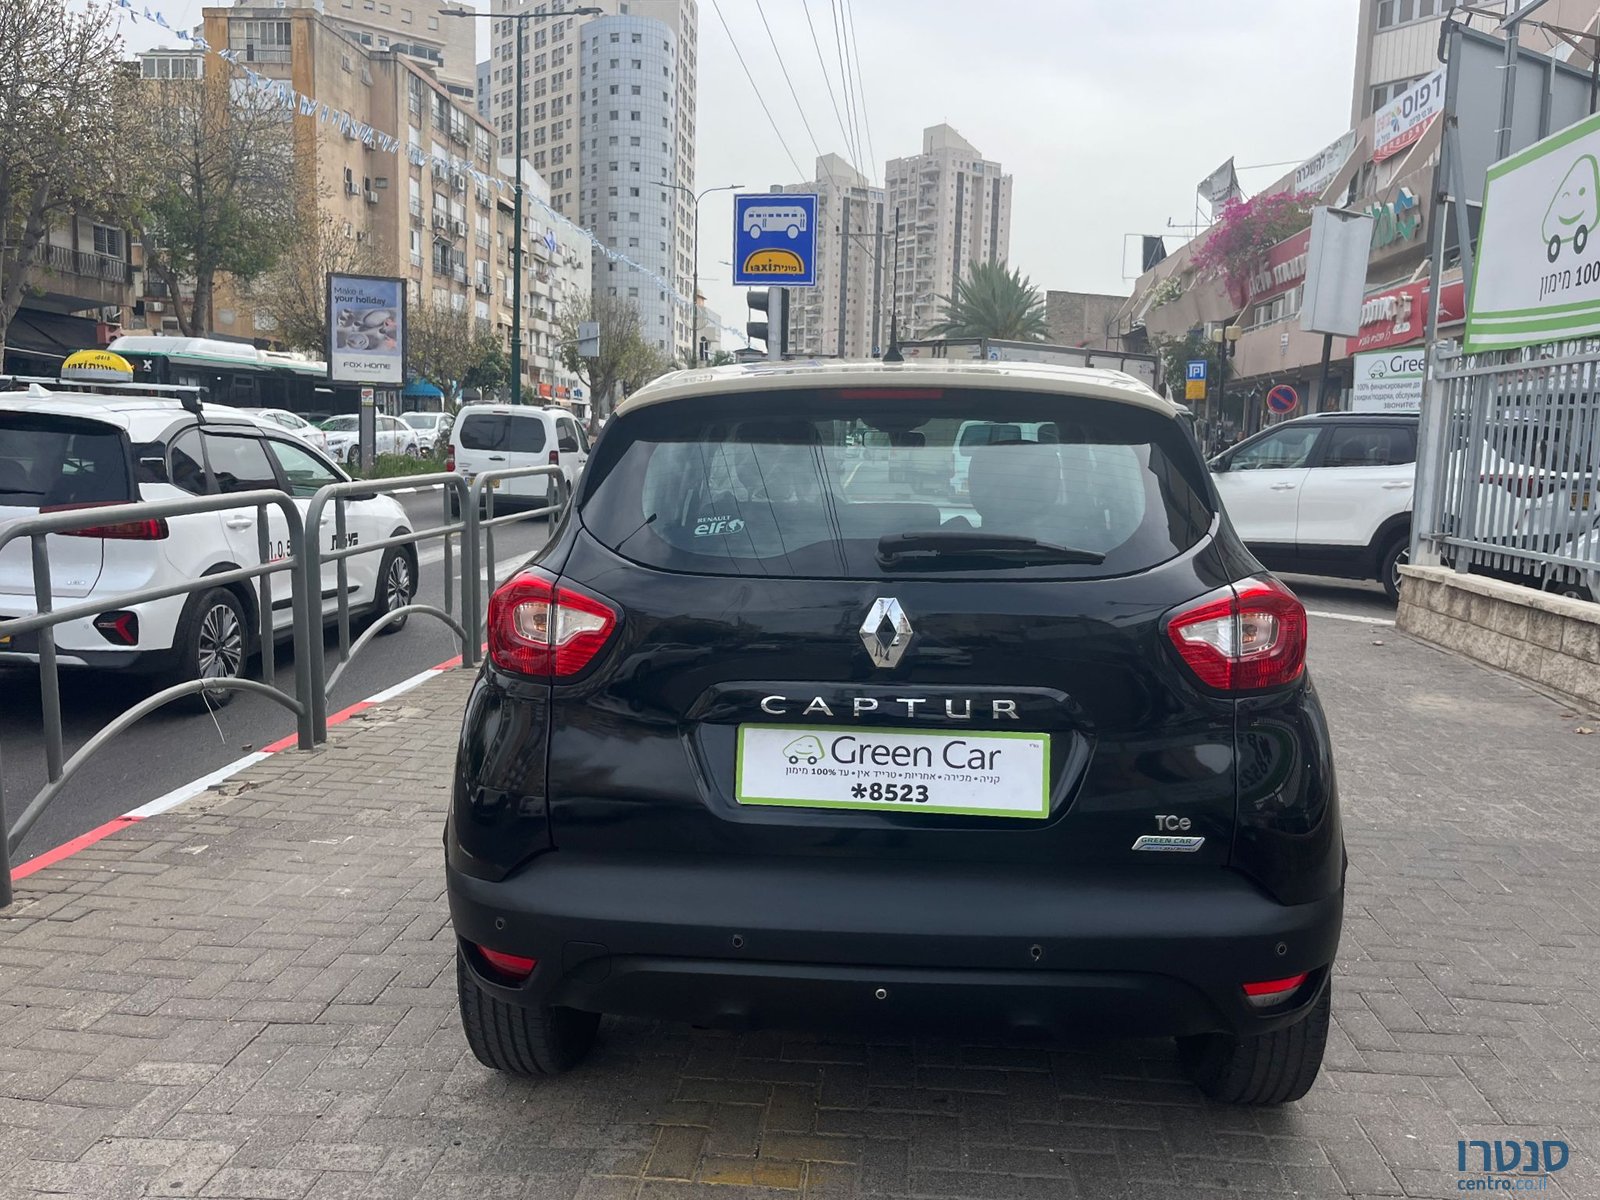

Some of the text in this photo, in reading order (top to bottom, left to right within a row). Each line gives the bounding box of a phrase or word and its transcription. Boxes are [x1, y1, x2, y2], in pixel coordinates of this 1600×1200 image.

[1402, 73, 1442, 118] דפוס
[334, 287, 357, 295] Make
[1539, 270, 1571, 302] מימון
[334, 295, 387, 307] your holiday
[697, 515, 731, 523] RENAULT
[760, 695, 1021, 720] CAPTUR
[830, 735, 1002, 770] Green Car
[785, 766, 1000, 785] קניה מכירה אחריות טרייד אין עד 100% מימון
[1155, 814, 1192, 831] TCe
